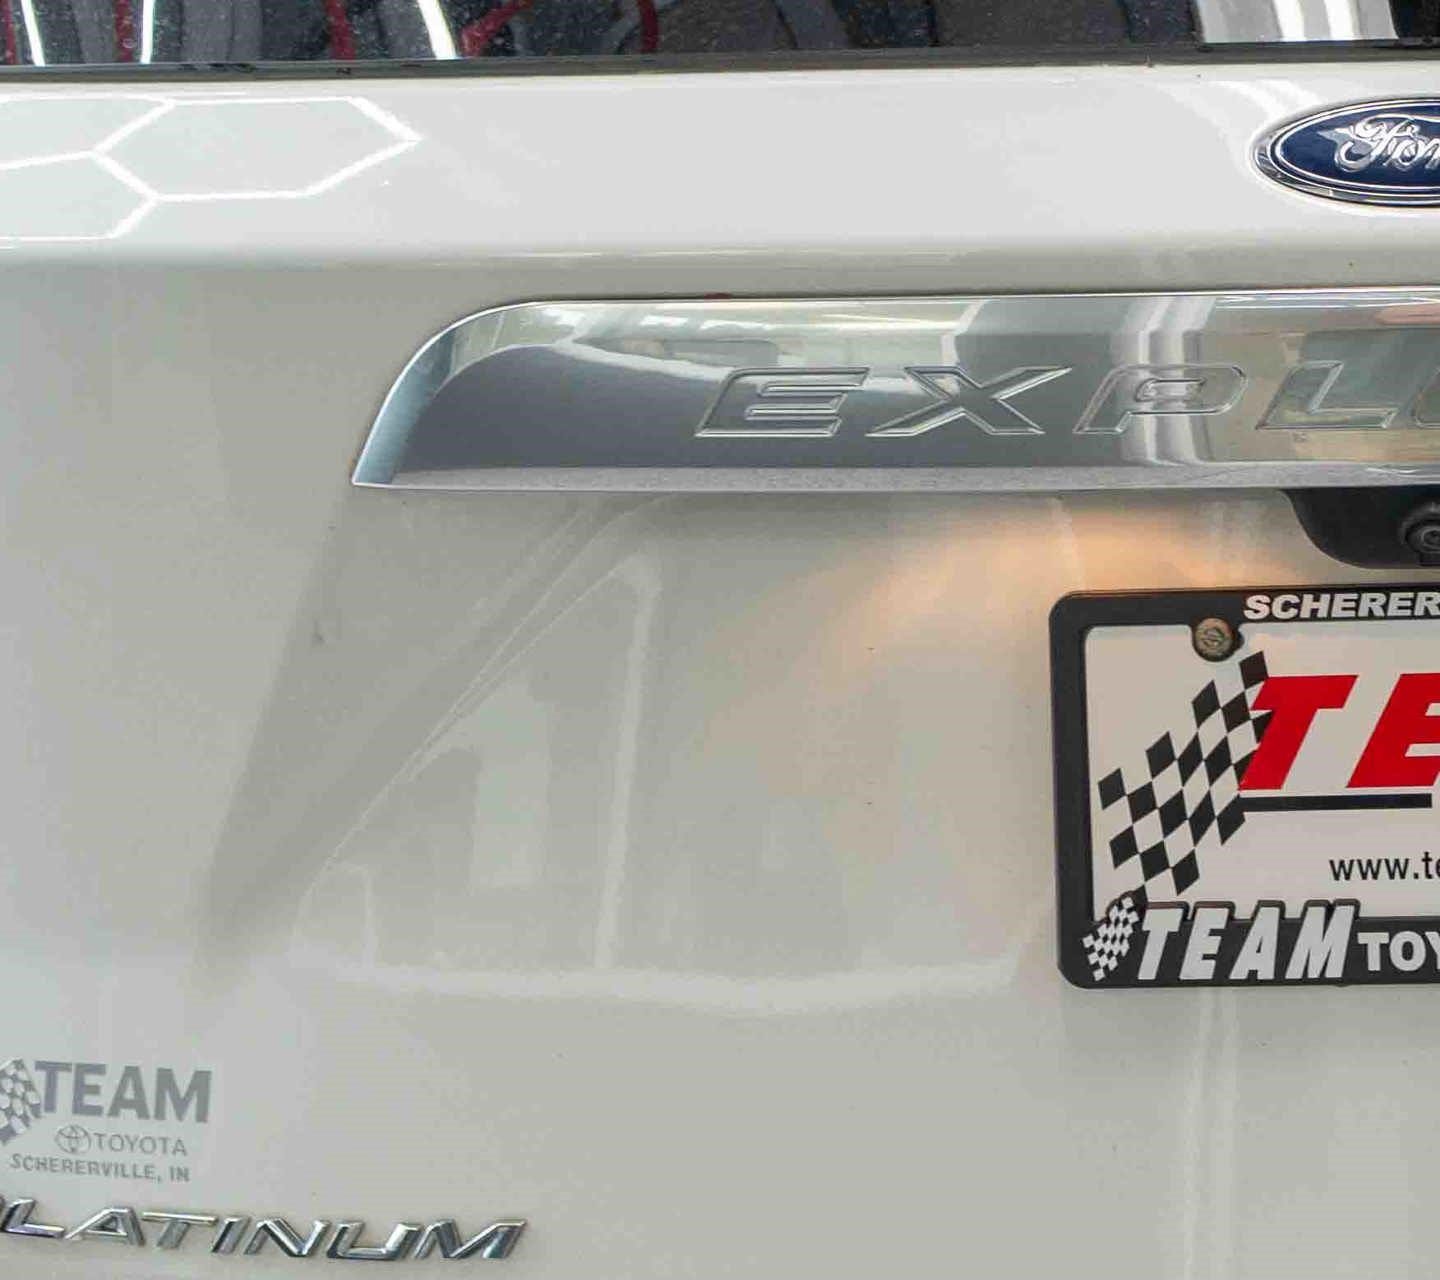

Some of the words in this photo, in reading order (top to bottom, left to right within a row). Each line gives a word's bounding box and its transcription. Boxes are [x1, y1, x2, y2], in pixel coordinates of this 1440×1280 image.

[1137, 904, 1359, 981] TEAM
[34, 1060, 213, 1124] TEAM
[92, 1131, 189, 1157] TOYOTA
[10, 1153, 163, 1183] SCHERERVILLE,
[169, 1167, 191, 1183] IN
